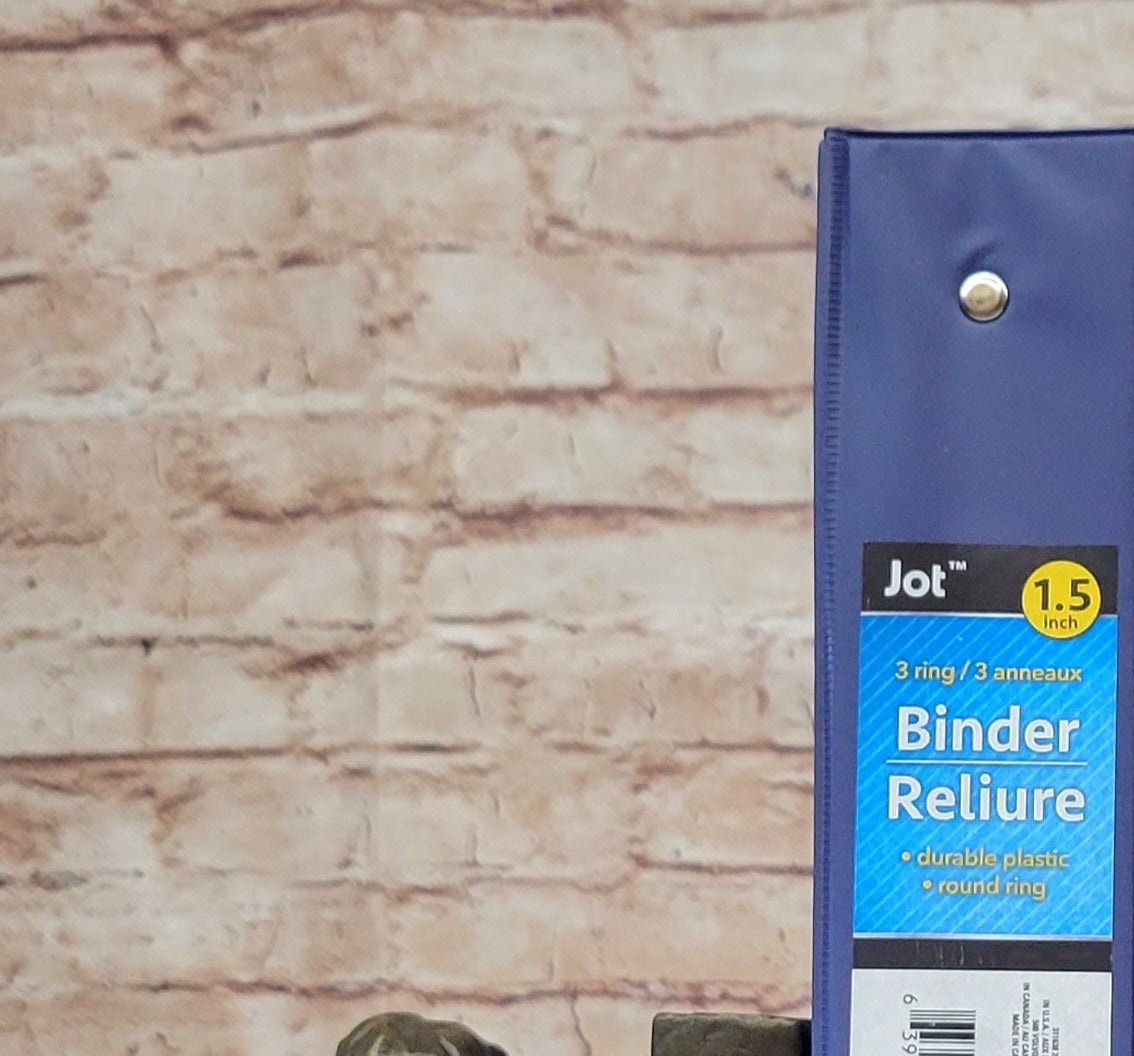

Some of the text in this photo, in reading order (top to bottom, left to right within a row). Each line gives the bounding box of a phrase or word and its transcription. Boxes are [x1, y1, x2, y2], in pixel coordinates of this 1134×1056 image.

[1034, 578, 1091, 612] 1.5
[1044, 615, 1078, 630] inch
[895, 660, 1082, 686] 3 ring / 3 anneaux
[898, 703, 1080, 753] Binder
[888, 773, 1085, 822] Reliure
[917, 846, 1070, 871] durable plastic
[938, 876, 1046, 902] round ring
[903, 993, 918, 1005] 6
